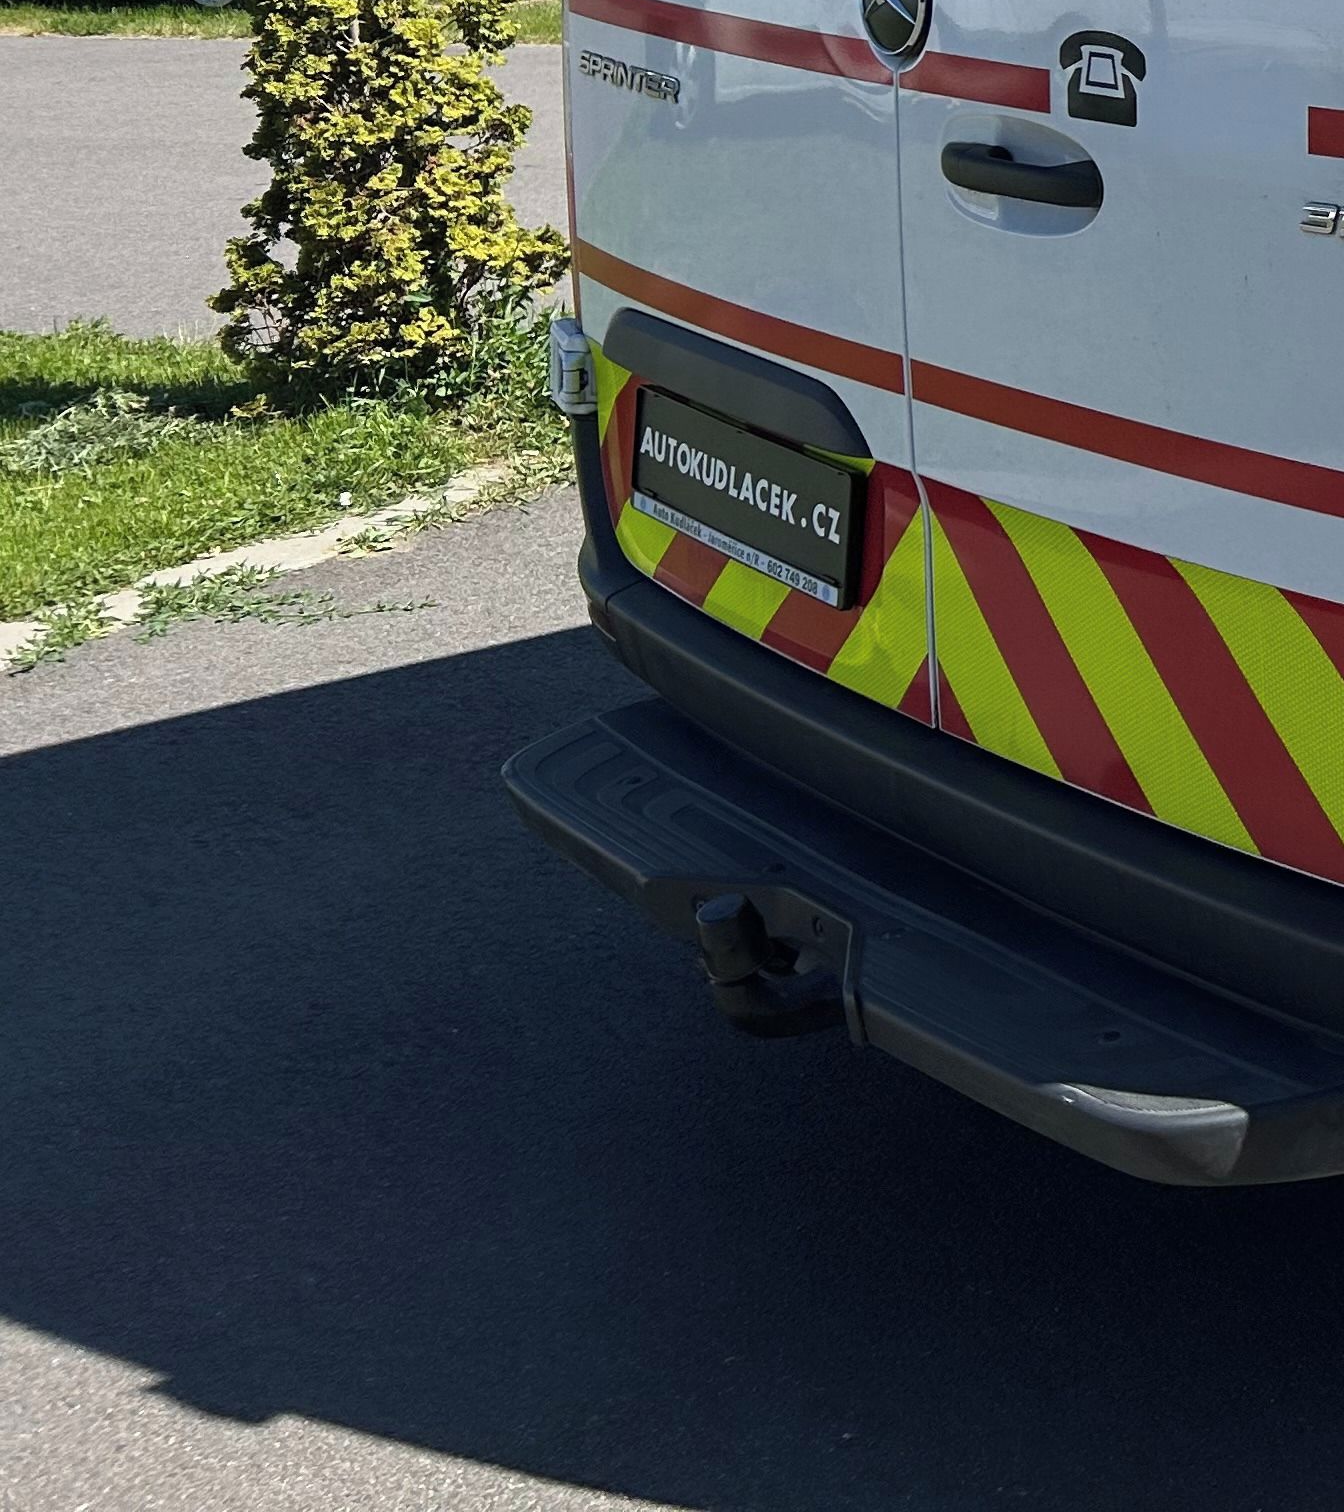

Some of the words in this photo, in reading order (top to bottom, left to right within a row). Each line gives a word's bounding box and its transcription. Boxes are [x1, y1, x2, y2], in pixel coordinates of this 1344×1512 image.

[578, 49, 681, 105] SPRINTER
[652, 503, 670, 521] Auto
[766, 560, 783, 578] 602
[784, 568, 801, 586] 749
[801, 577, 819, 595] 208
